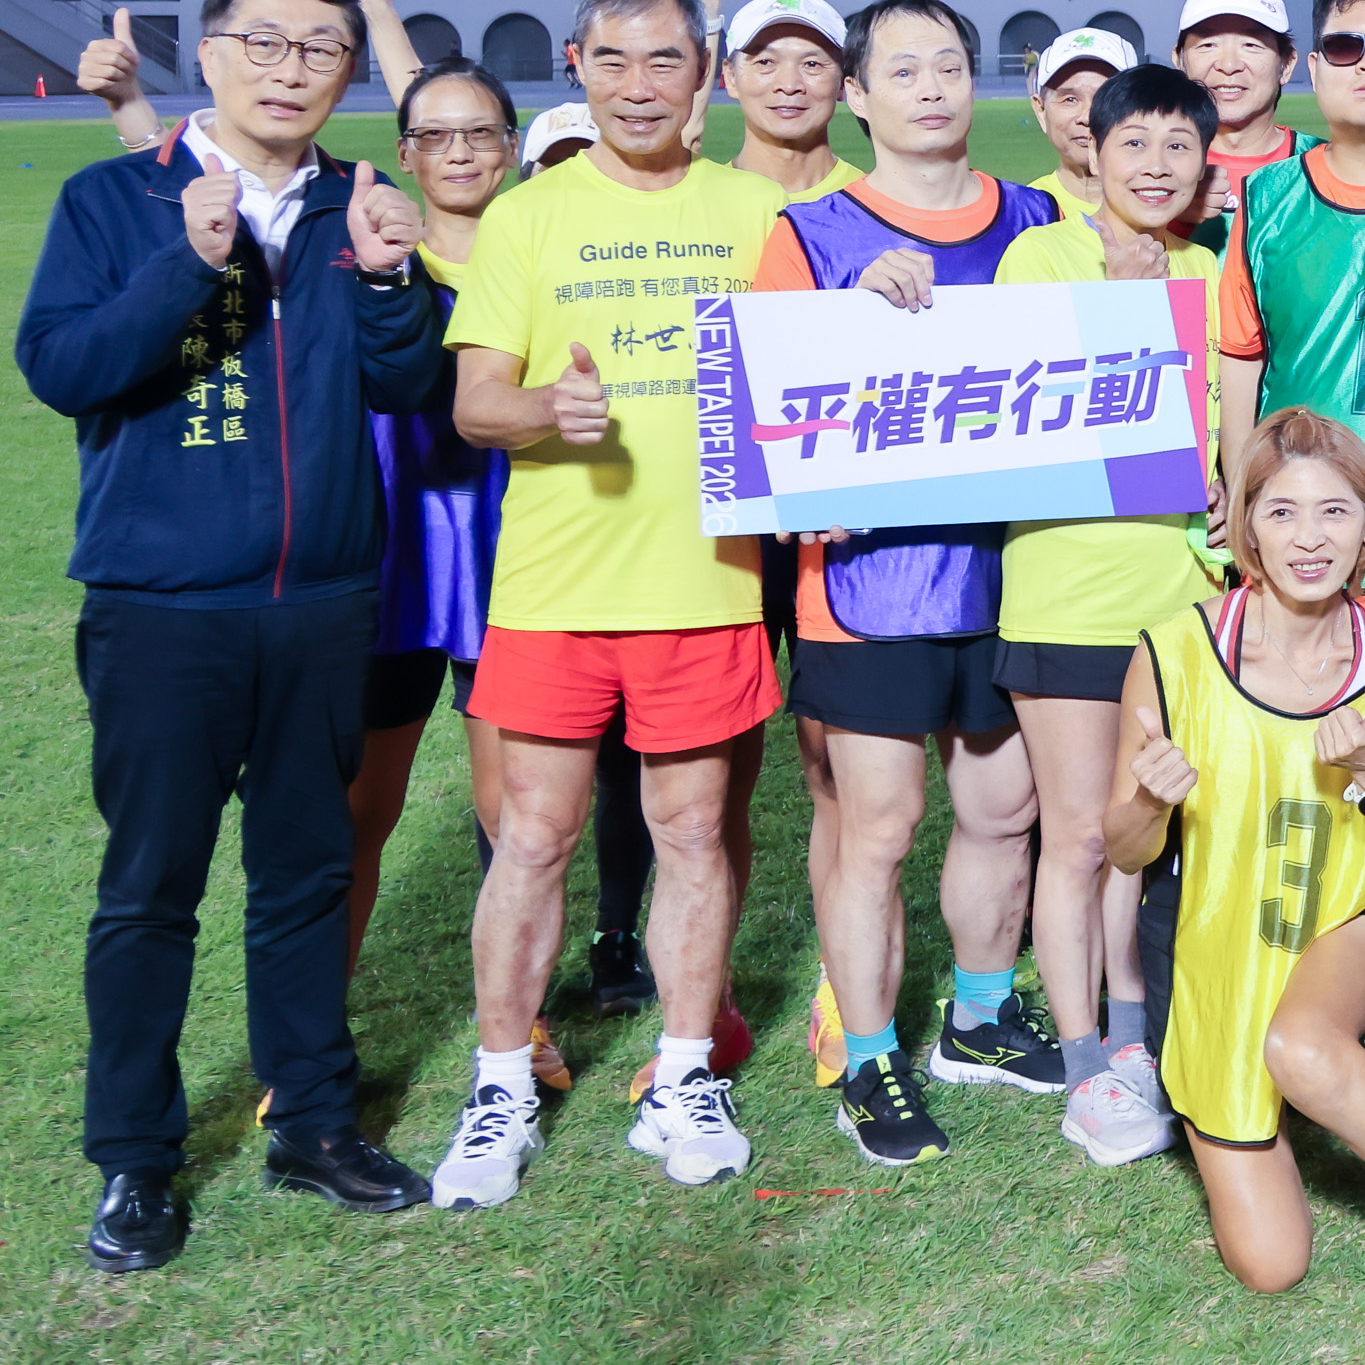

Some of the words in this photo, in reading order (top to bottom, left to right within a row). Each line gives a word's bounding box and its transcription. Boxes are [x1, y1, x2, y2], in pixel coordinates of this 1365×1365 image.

[579, 241, 648, 262] Guide
[656, 240, 734, 259] Runner
[554, 278, 635, 305] 視障陪跑
[640, 276, 719, 297] 有您真好
[725, 277, 754, 294] 202
[611, 321, 695, 356] 林世
[695, 294, 733, 372] NEW
[697, 375, 736, 459] TAIPEI
[751, 347, 1192, 460] 平權有行動
[700, 464, 738, 536] 2026
[1259, 797, 1333, 954] 3
